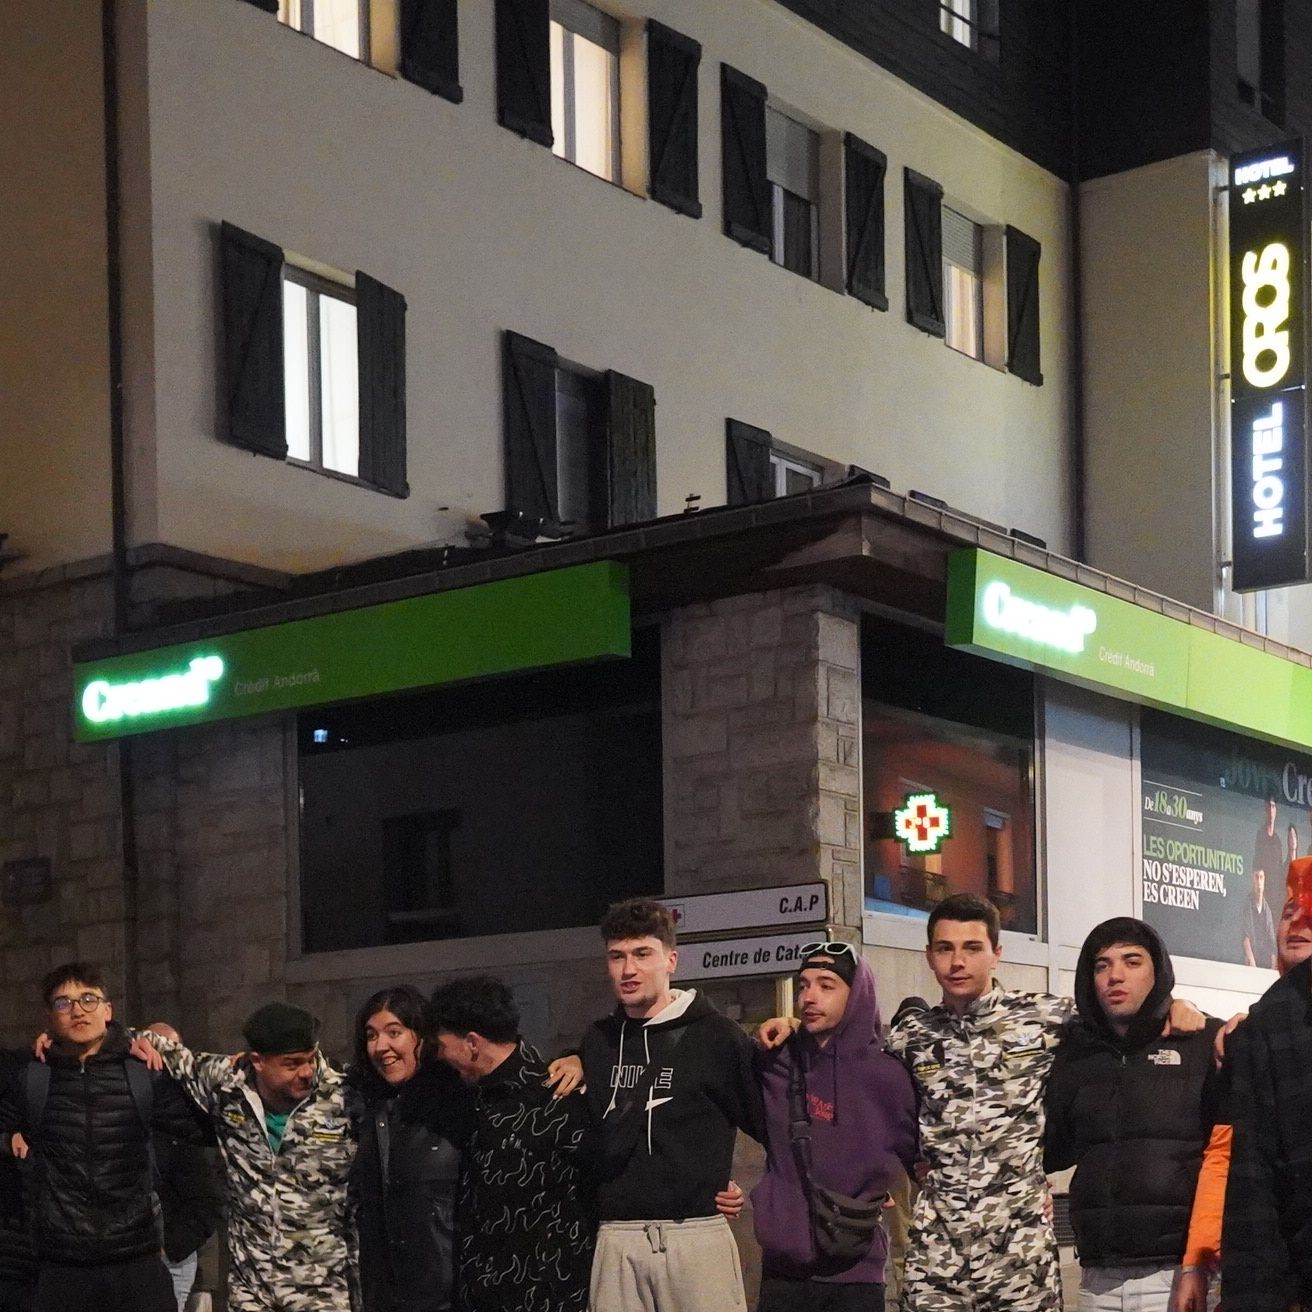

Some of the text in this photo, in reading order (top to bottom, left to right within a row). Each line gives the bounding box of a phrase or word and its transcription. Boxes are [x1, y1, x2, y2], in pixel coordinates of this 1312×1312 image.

[1234, 157, 1295, 186] HOTEL
[1242, 242, 1290, 539] HOTEL OROS
[1153, 790, 1168, 814] 18
[1171, 795, 1187, 819] 30
[1144, 834, 1244, 876] LES OPORTUNITATS
[1143, 859, 1162, 882] NO
[778, 894, 819, 914] C.A.P
[1144, 881, 1200, 910] ES CREEN
[703, 944, 803, 969] Centre de Cat
